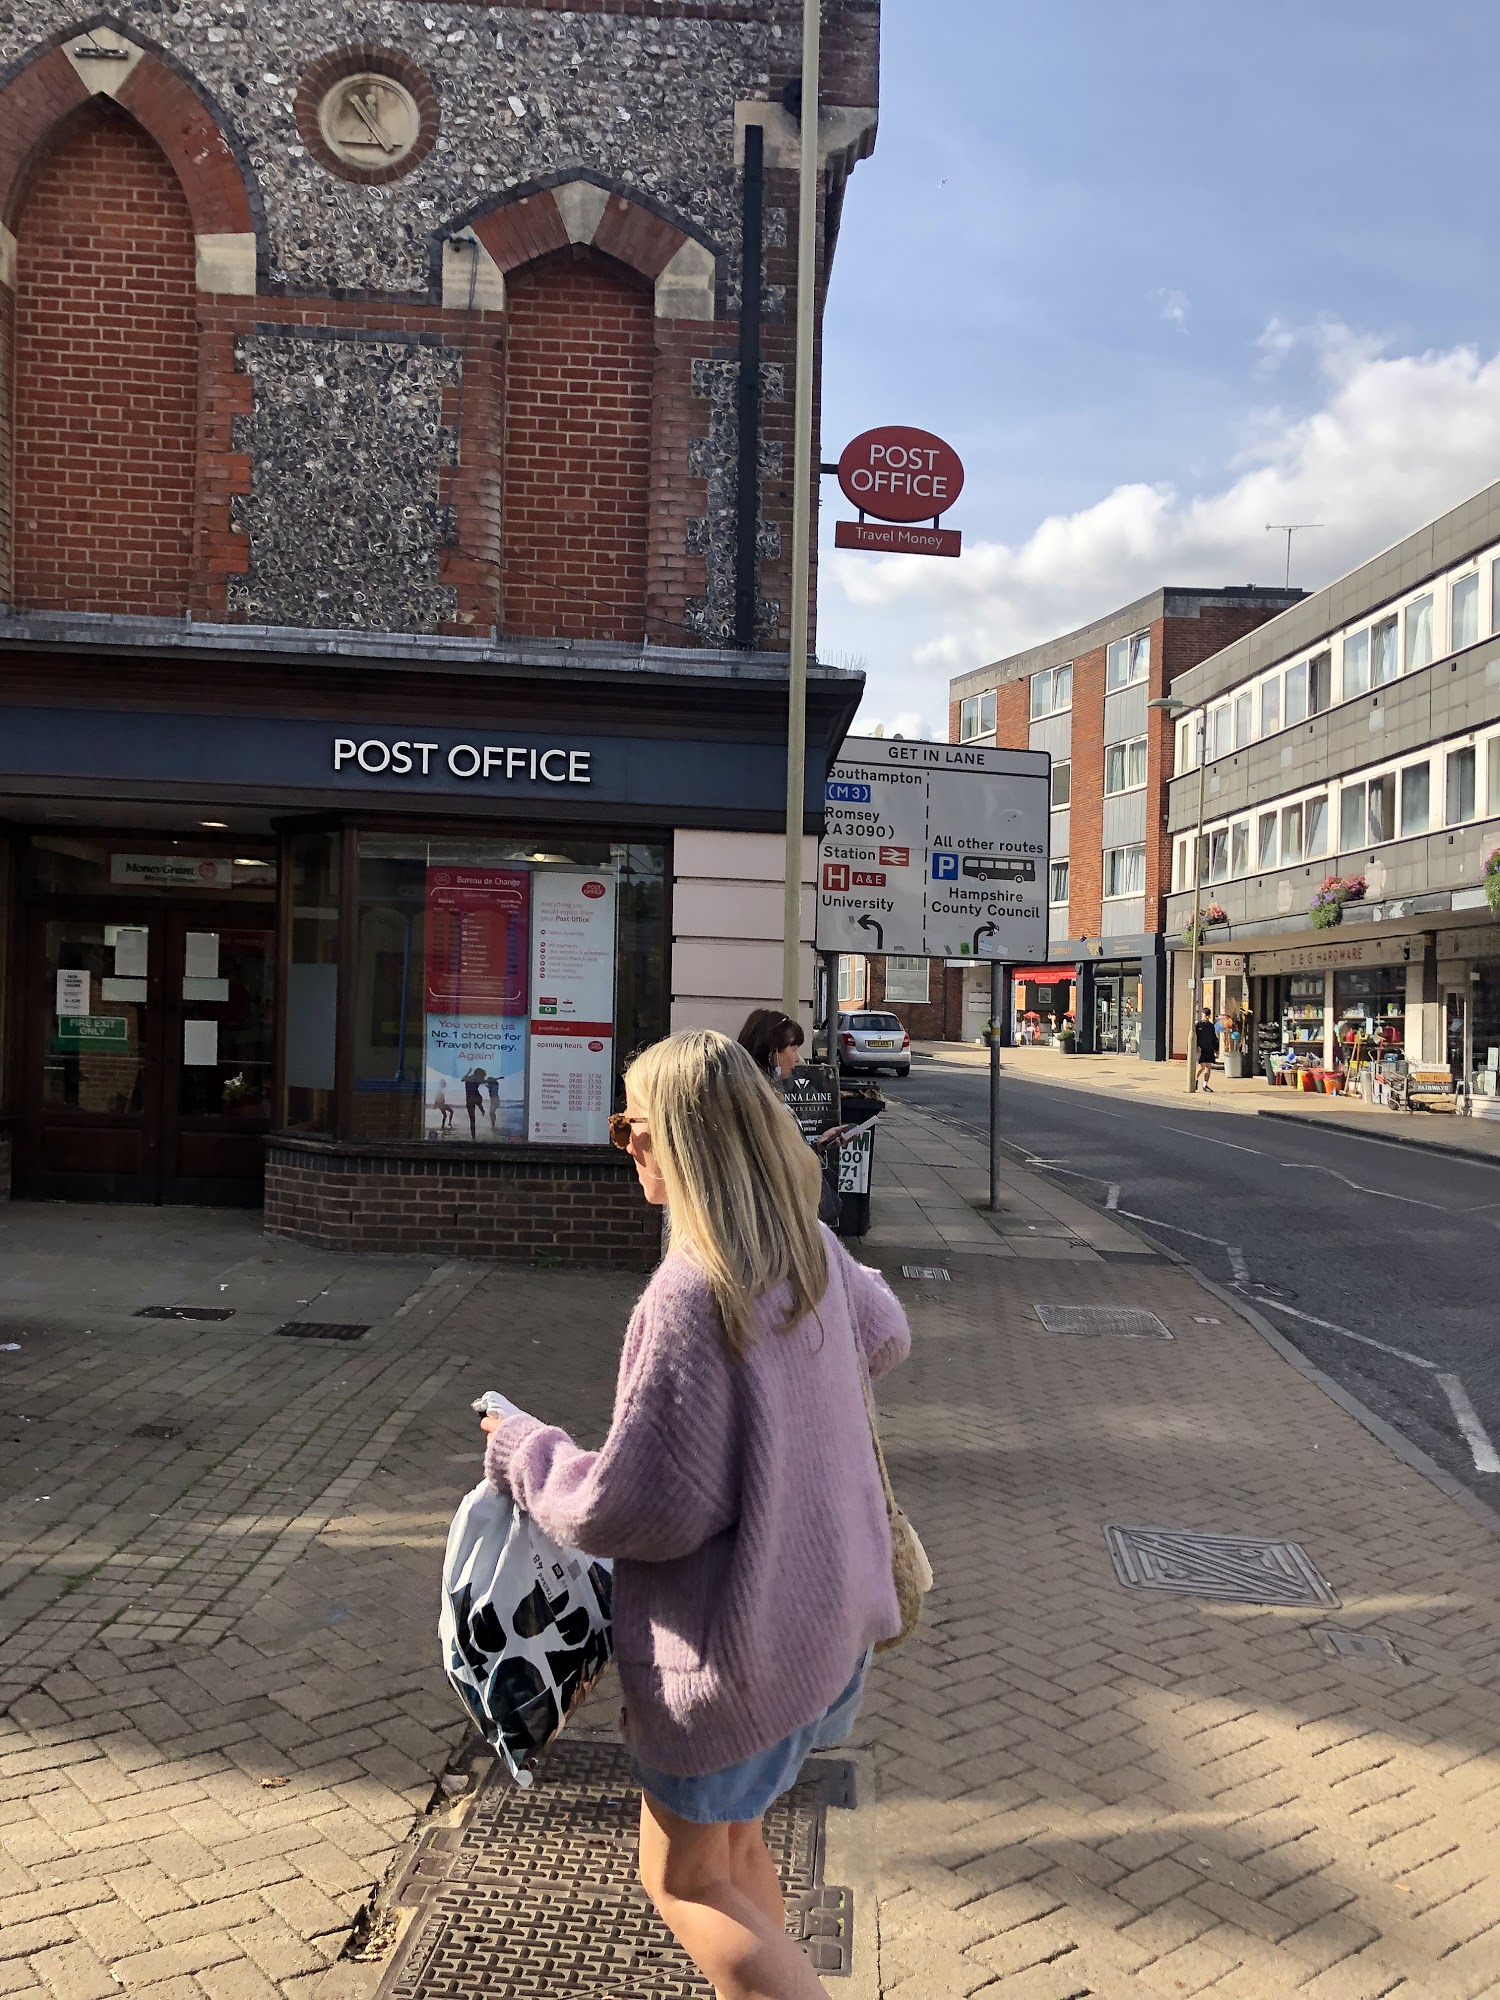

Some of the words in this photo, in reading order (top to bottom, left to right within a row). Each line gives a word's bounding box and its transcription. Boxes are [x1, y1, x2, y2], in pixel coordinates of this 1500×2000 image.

[870, 444, 940, 471] POST
[850, 468, 948, 498] OFFICE
[856, 526, 894, 542] Travel
[898, 531, 943, 549] Money
[334, 738, 438, 774] POST
[448, 744, 591, 783] OFFICE
[888, 746, 918, 760] GET
[923, 750, 939, 762] IN
[945, 752, 985, 765] LANE
[827, 766, 922, 785] Southampton
[828, 786, 870, 801] (M3)
[825, 806, 880, 823] Romsey
[933, 835, 953, 848] All
[956, 838, 994, 852] other
[1000, 840, 1044, 854] routes
[824, 846, 876, 861] Station
[456, 875, 483, 885] Bureau
[494, 877, 521, 887] Change
[949, 887, 1024, 903] Hampshire
[822, 894, 894, 912] University
[931, 901, 982, 917] County
[987, 904, 1040, 919] Council
[555, 915, 571, 923] Post
[1317, 947, 1362, 962] HARDWARE
[70, 1018, 92, 1027] FIRE
[94, 1020, 115, 1028] EXIT
[438, 1019, 461, 1029] You
[464, 1020, 498, 1030] voted
[501, 1023, 515, 1031] us
[79, 1027, 105, 1035] ONLY
[461, 1031, 501, 1040] choice
[504, 1032, 522, 1041] for
[435, 1040, 472, 1050] Travel
[474, 1041, 517, 1053] Money.
[537, 1042, 563, 1050] opening
[457, 1052, 495, 1062] Again!
[806, 1092, 832, 1101] LAINE
[532, 1554, 544, 1569] 48
[537, 1572, 554, 1600] Tracked
